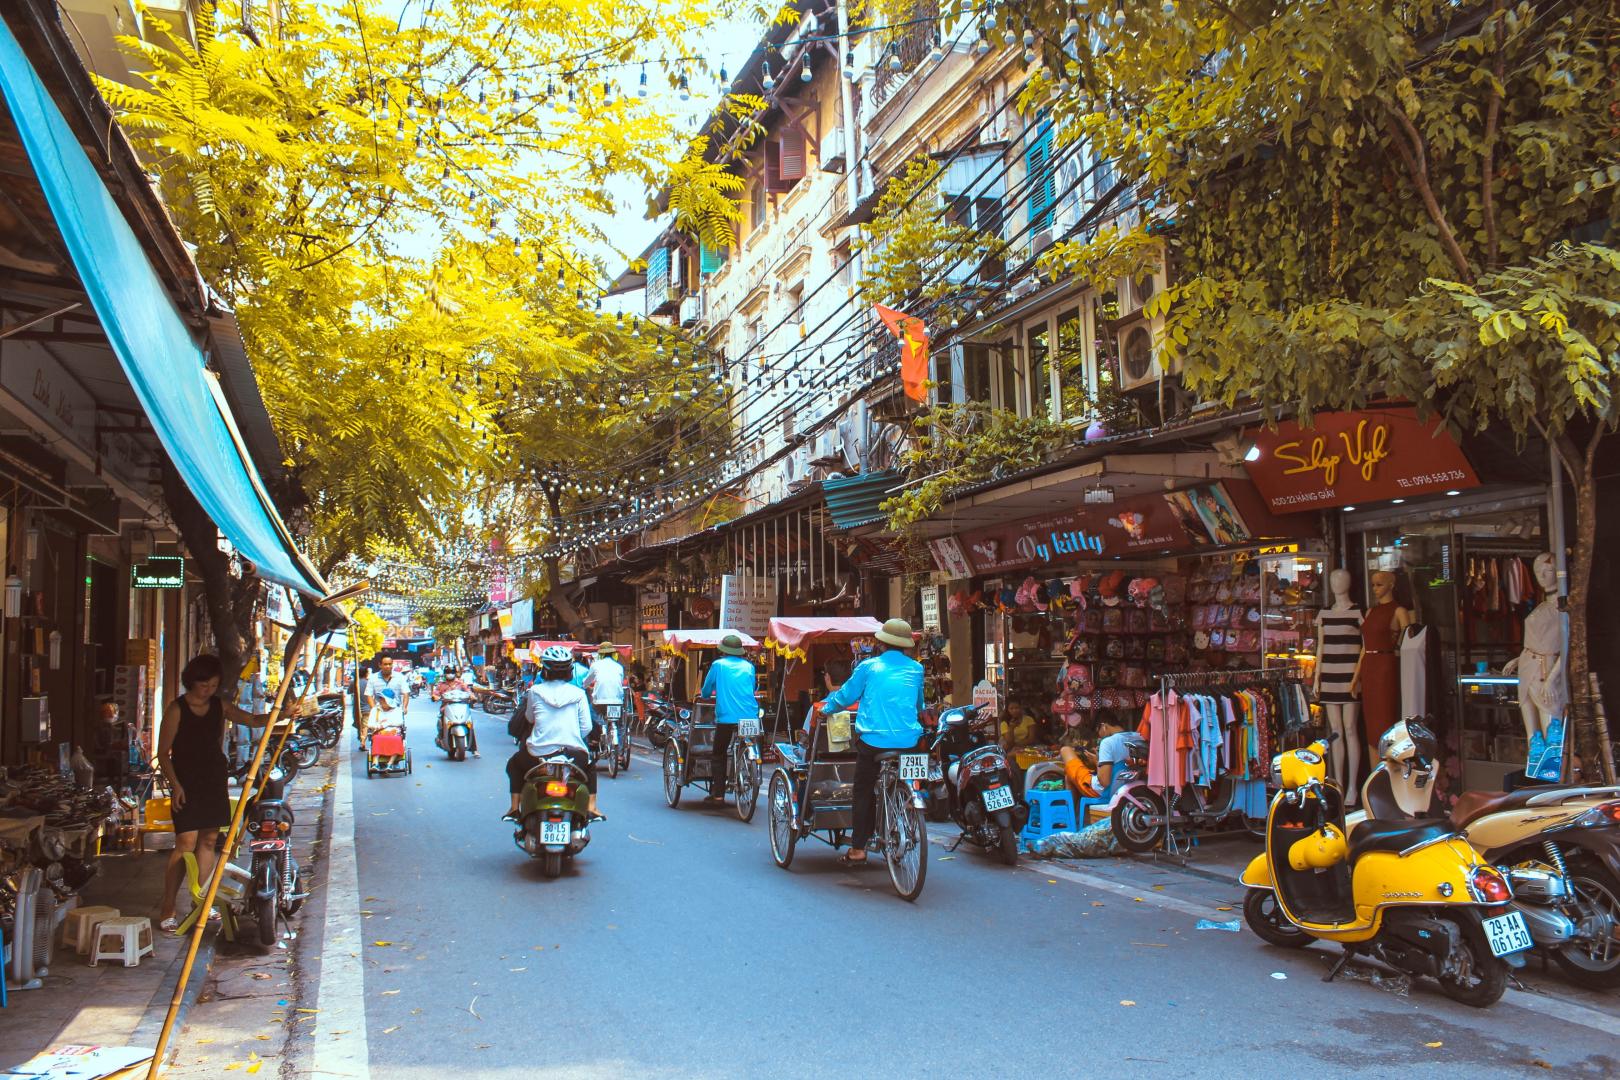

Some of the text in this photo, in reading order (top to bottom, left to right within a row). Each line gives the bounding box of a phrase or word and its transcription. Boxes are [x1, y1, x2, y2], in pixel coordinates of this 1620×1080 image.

[1433, 473, 1450, 483] 558
[1448, 469, 1466, 481] 736
[905, 756, 924, 766] 29XL
[902, 767, 926, 778] 0136
[1489, 914, 1520, 936] 29-AA
[1492, 930, 1529, 954] 061.50
